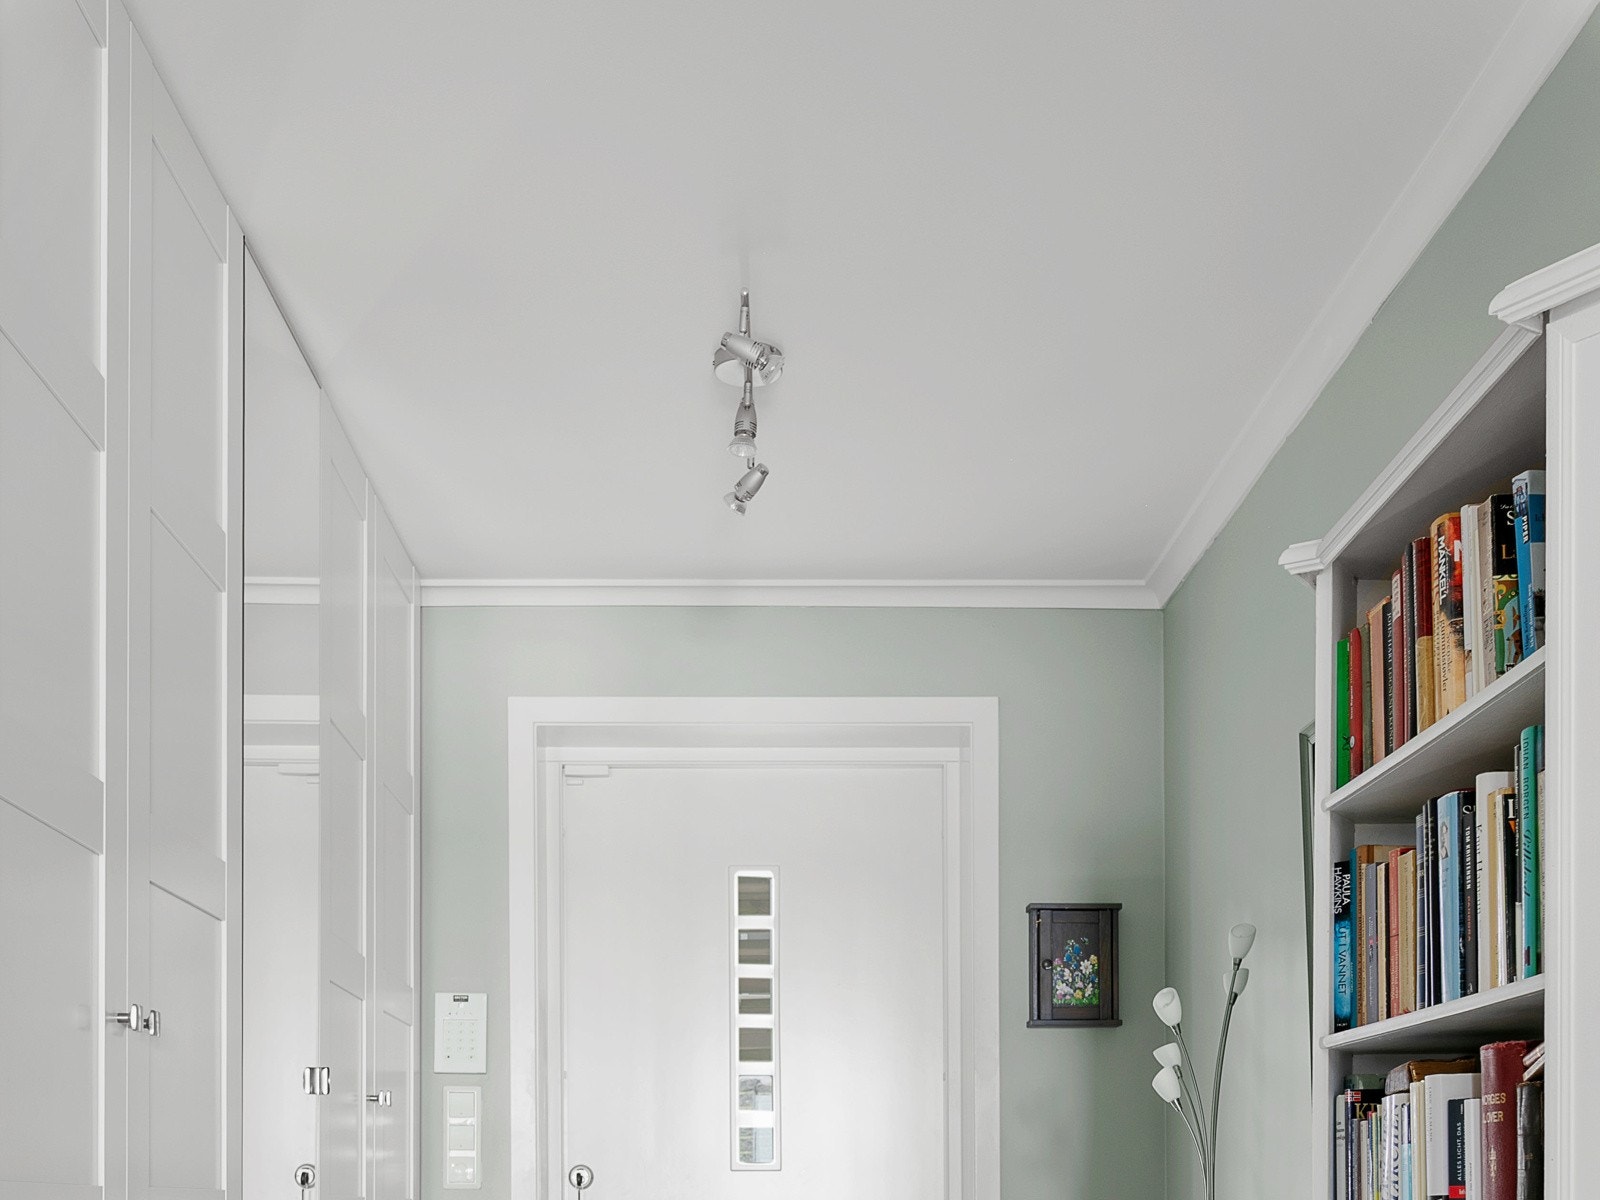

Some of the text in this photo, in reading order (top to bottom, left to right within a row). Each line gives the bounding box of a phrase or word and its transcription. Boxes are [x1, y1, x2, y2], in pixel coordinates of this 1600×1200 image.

[1438, 536, 1448, 606] MANKELL
[1334, 867, 1342, 915] HAWKINS
[1342, 873, 1350, 906] PAULA
[1337, 926, 1347, 941] UT
[1337, 949, 1347, 995] VANNET
[1483, 1111, 1504, 1124] LOVER
